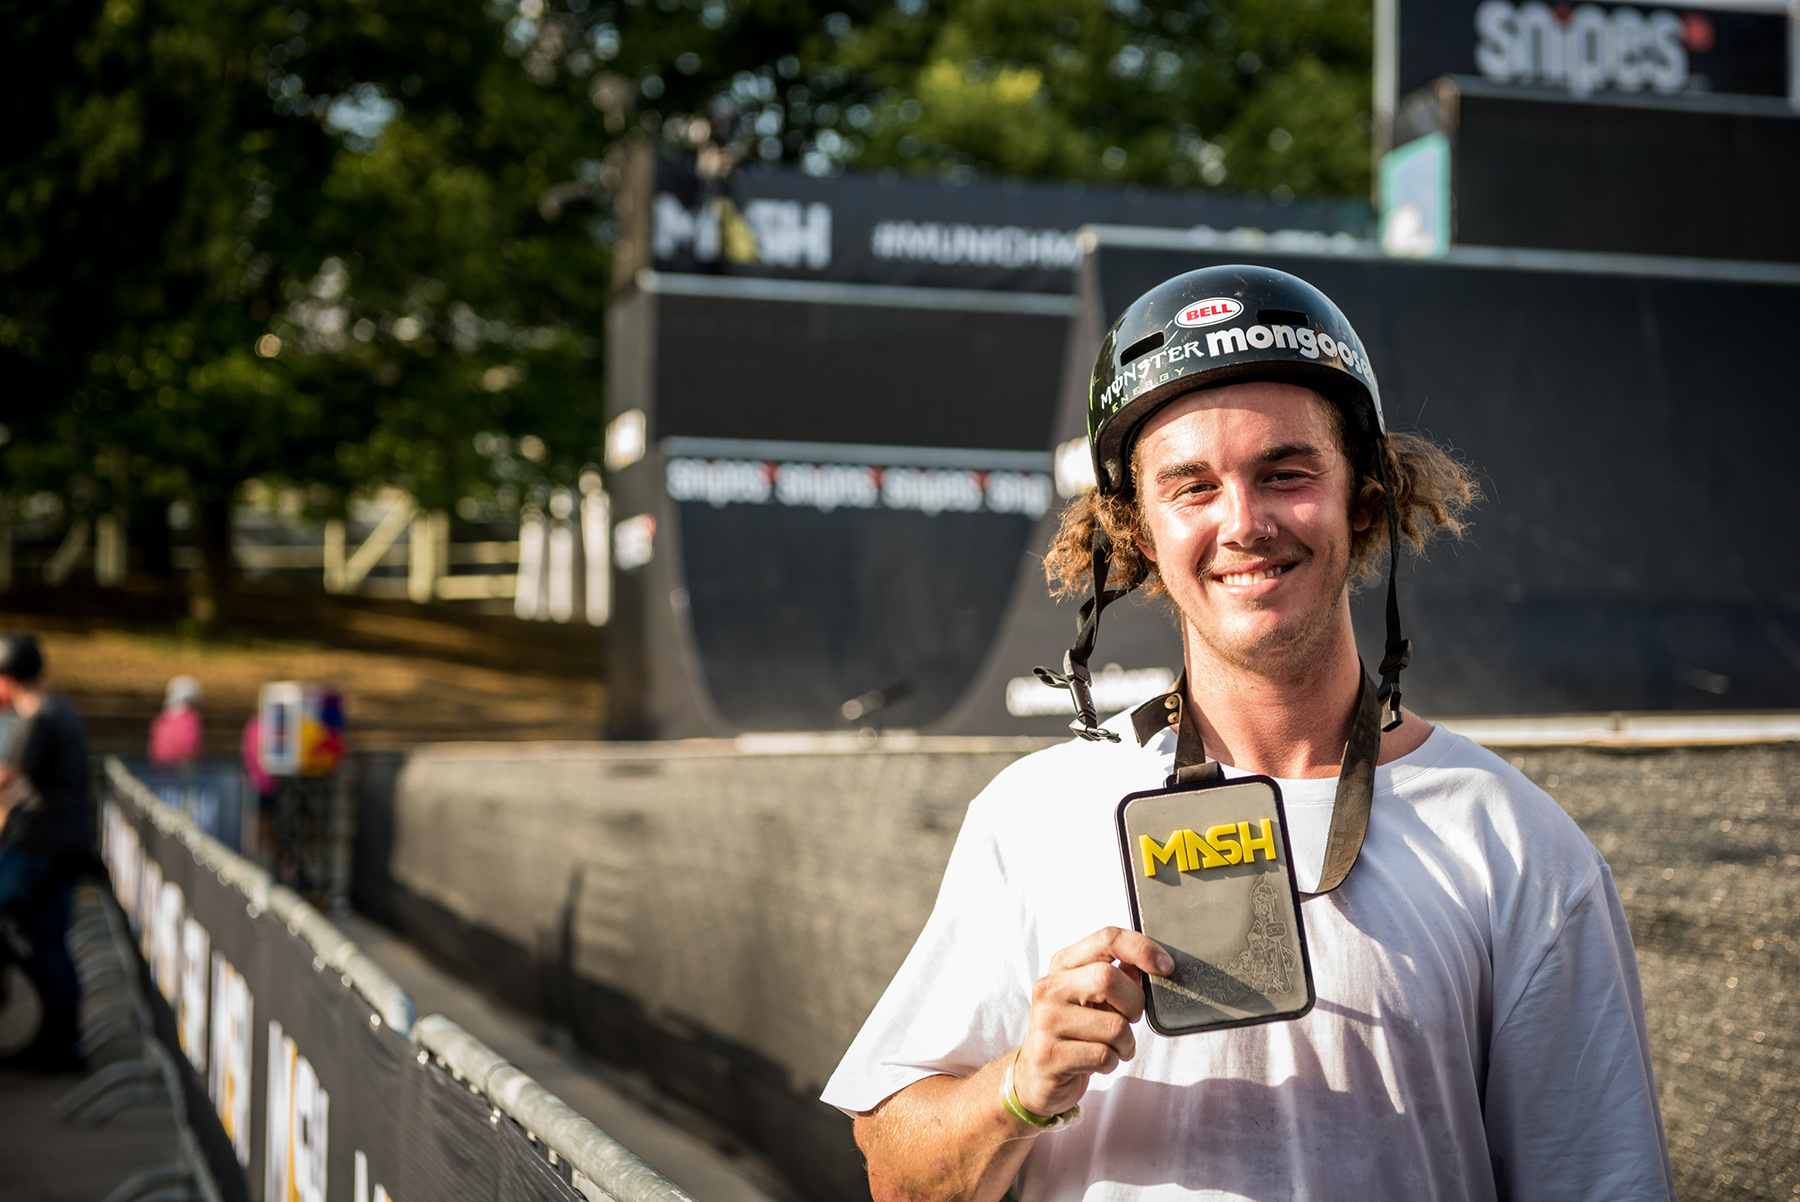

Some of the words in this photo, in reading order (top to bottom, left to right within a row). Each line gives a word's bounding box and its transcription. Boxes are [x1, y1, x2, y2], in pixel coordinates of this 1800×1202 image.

[1474, 0, 1690, 98] snipes
[653, 191, 833, 270] MASH
[1185, 303, 1233, 322] BELL
[1100, 340, 1205, 410] MONSTER
[1112, 366, 1185, 414] ENERGY
[1138, 817, 1278, 878] MASH
